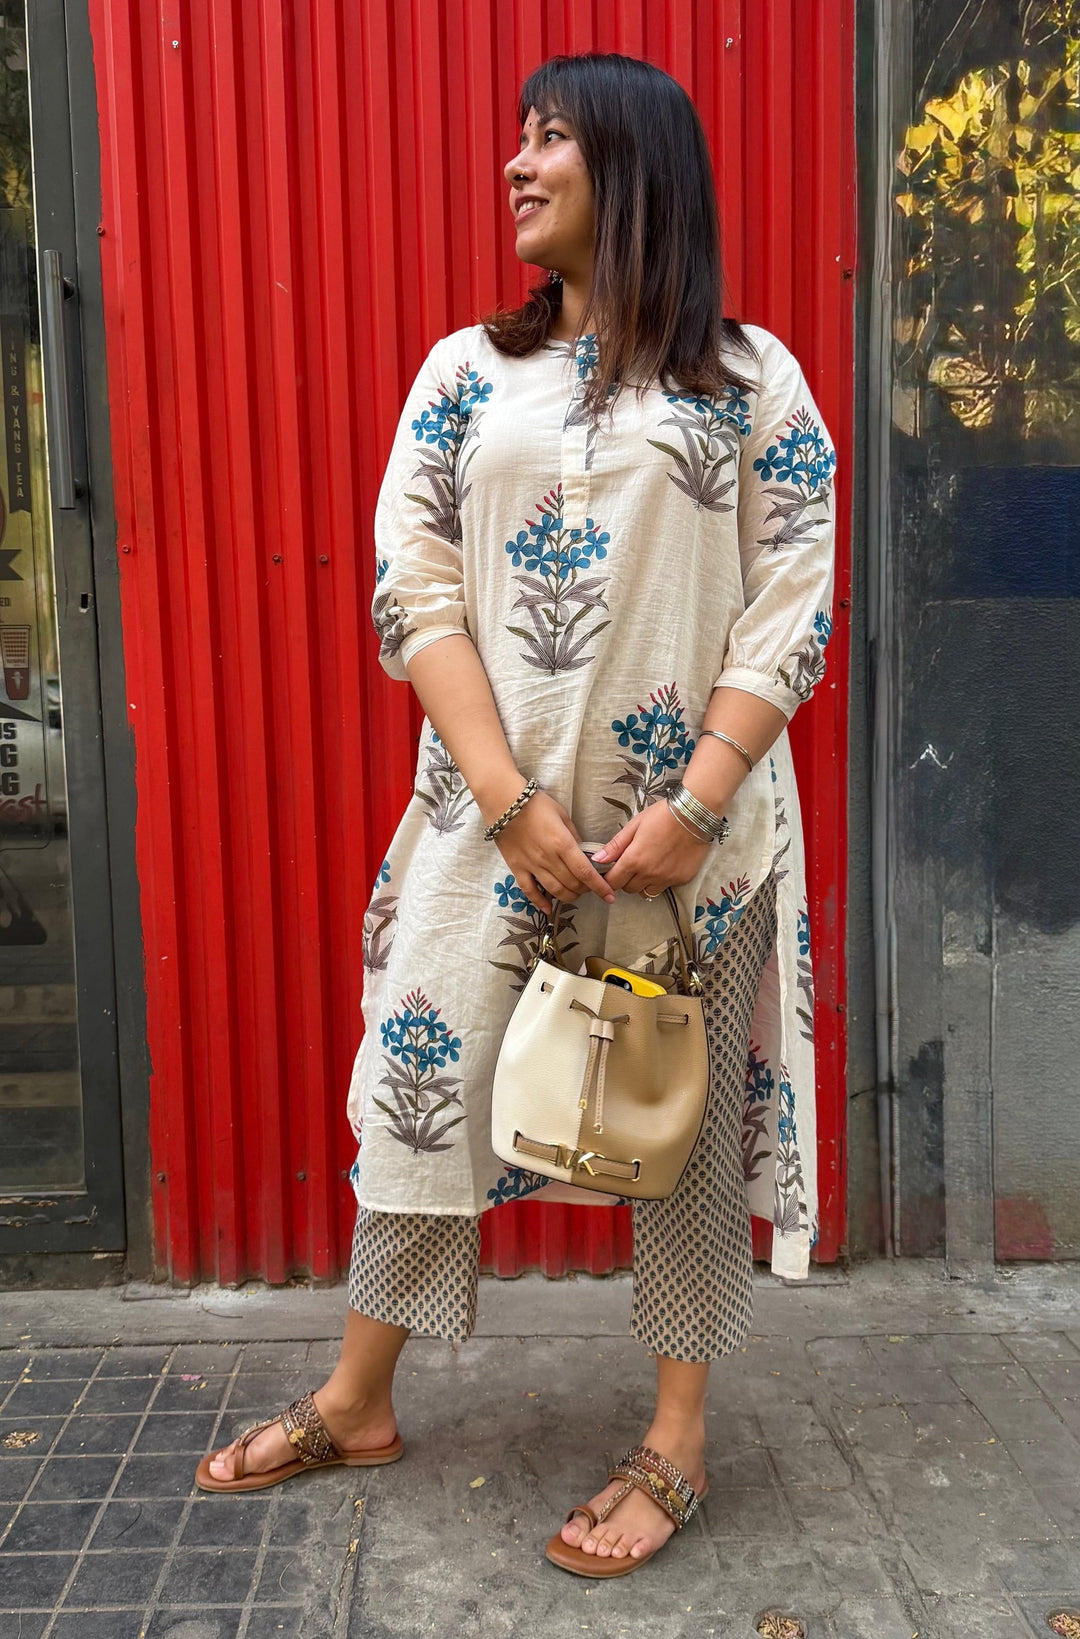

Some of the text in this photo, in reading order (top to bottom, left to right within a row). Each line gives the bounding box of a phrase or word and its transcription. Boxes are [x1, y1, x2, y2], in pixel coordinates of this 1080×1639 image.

[11, 384, 20, 397] &
[12, 405, 22, 454] YANG
[16, 462, 24, 498] TEA
